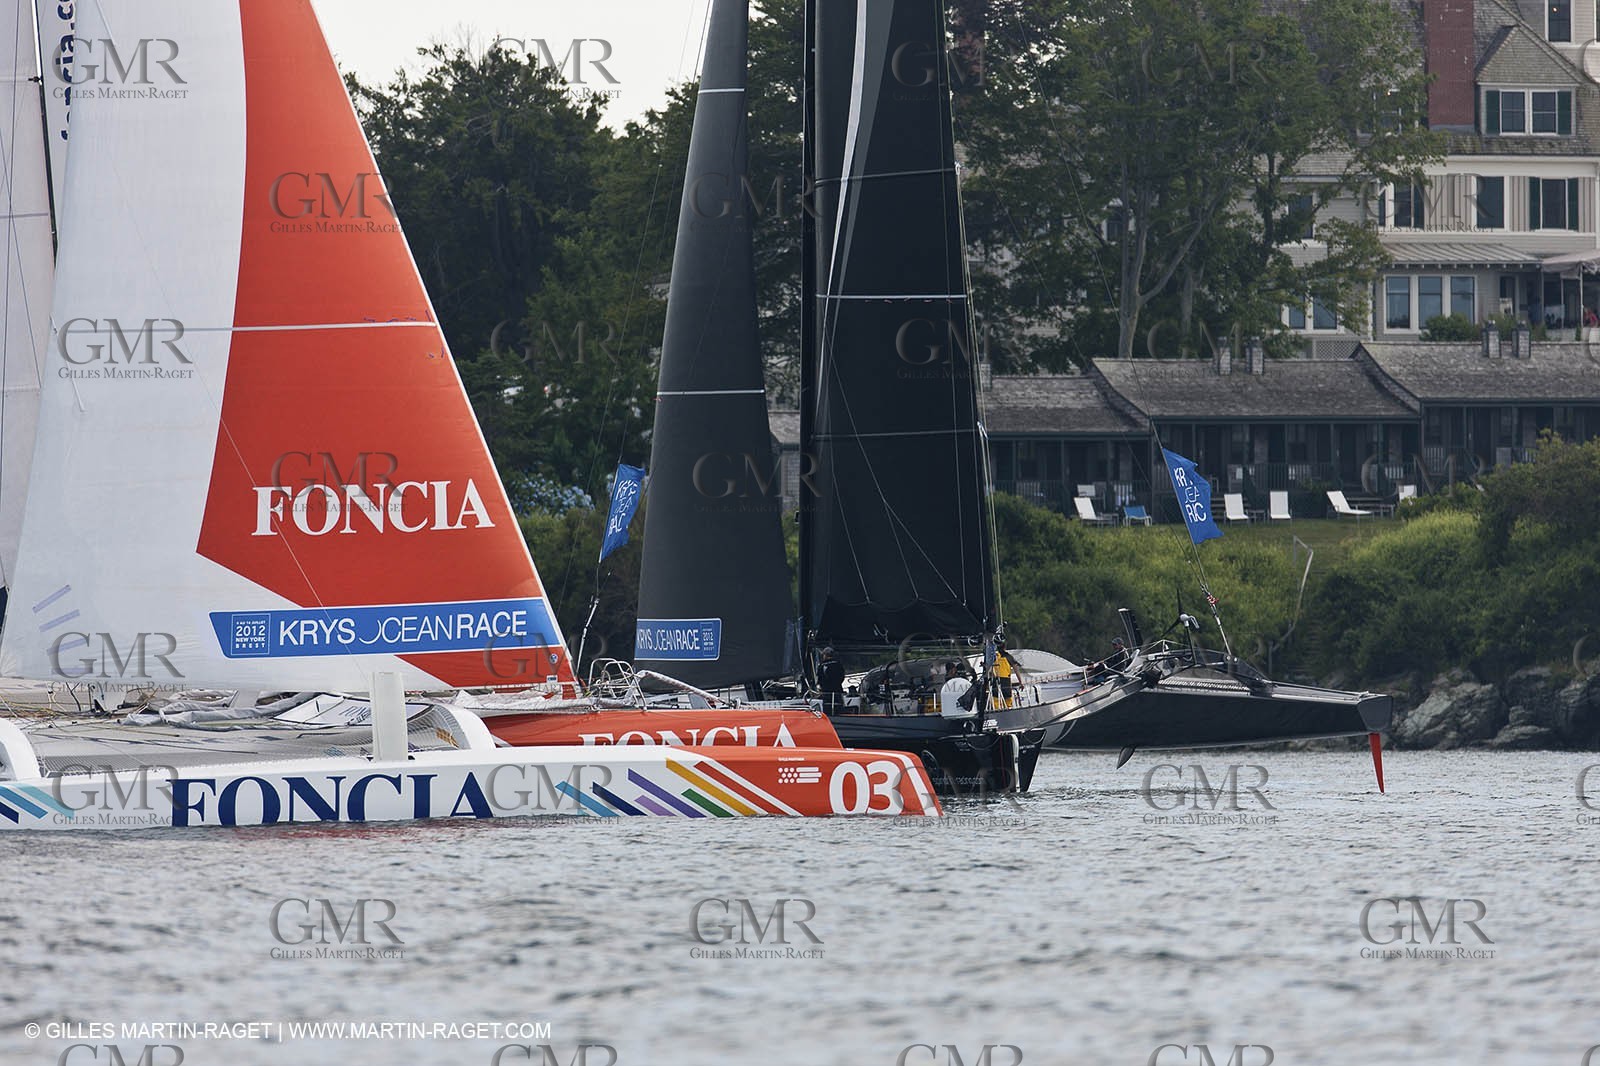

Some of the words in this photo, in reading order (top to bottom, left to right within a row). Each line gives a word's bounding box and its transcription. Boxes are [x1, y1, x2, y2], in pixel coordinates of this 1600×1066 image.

[250, 478, 496, 537] FONCIA
[236, 625, 266, 637] 2012
[279, 618, 356, 646] KRYS
[165, 771, 495, 828] FONCIA
[829, 760, 905, 815] 03
